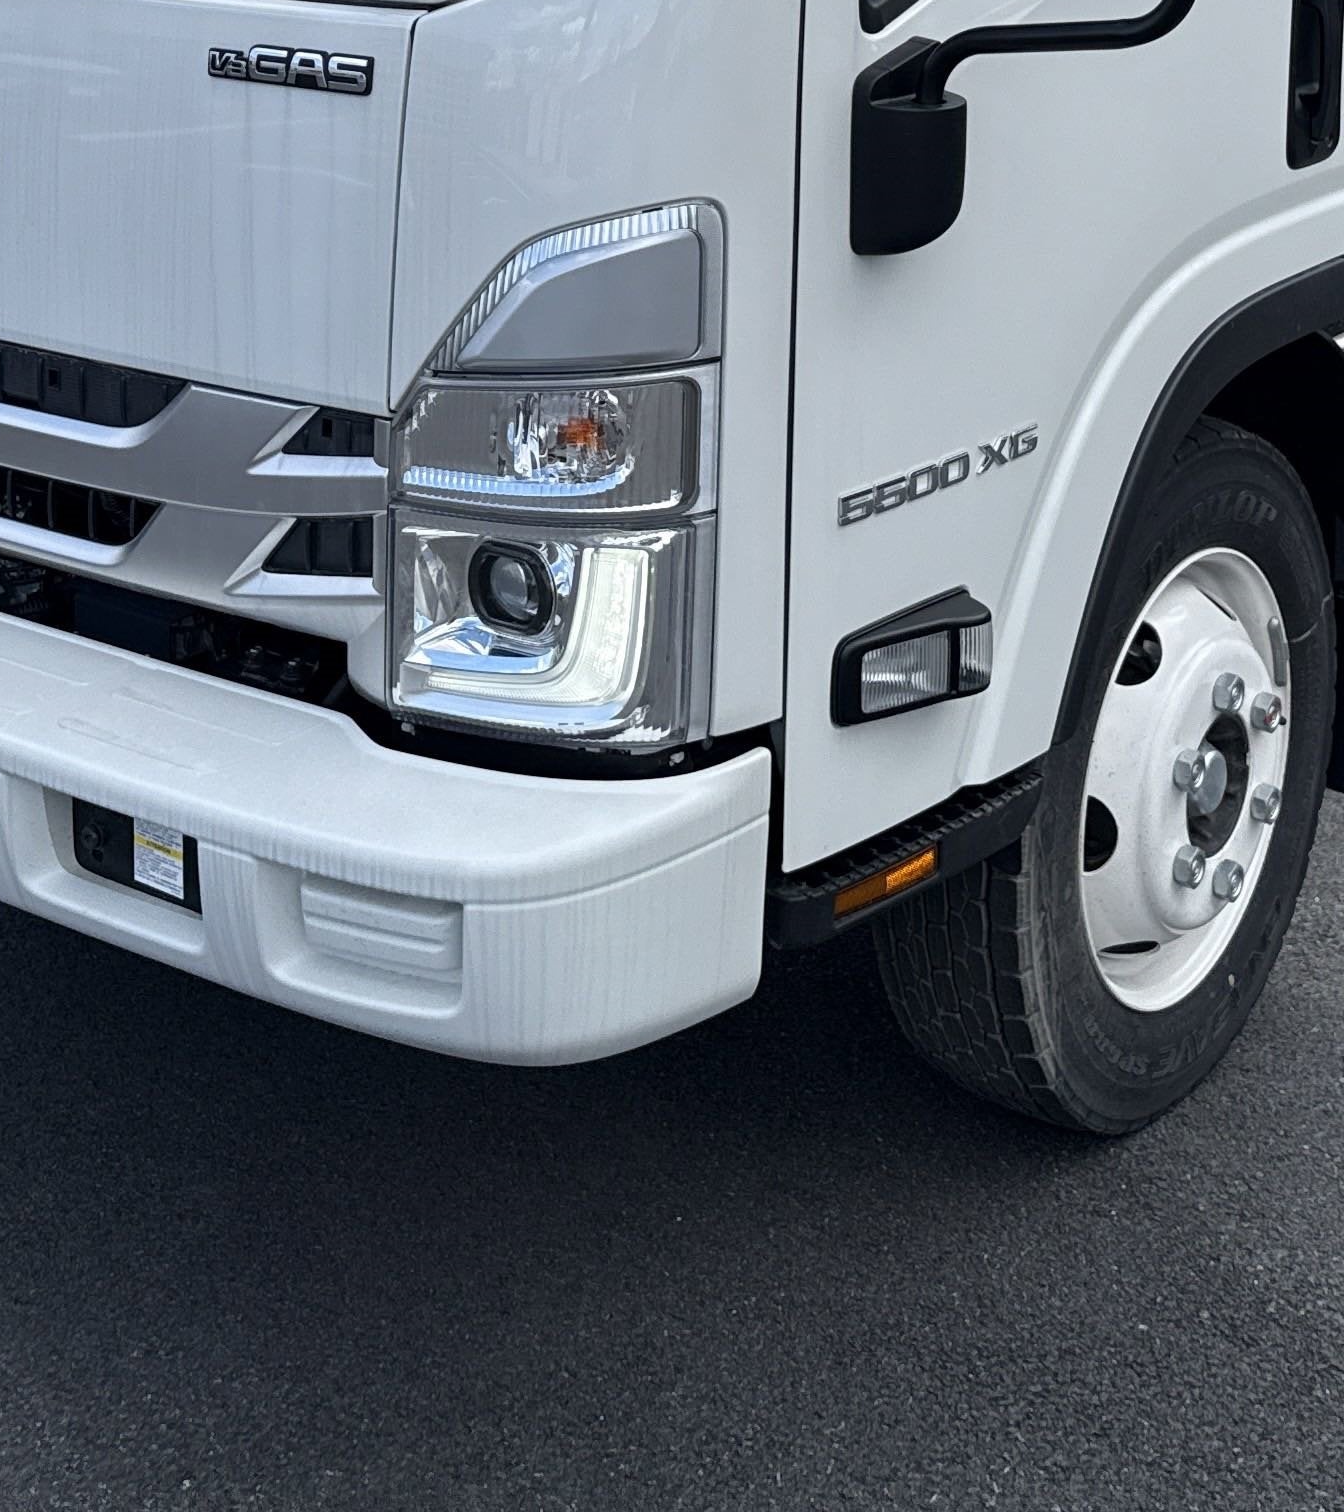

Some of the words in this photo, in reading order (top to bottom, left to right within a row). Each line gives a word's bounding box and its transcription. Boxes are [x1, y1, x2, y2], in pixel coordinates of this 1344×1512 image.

[248, 47, 369, 94] GAS
[837, 451, 971, 527] 5500
[975, 422, 1039, 475] XG
